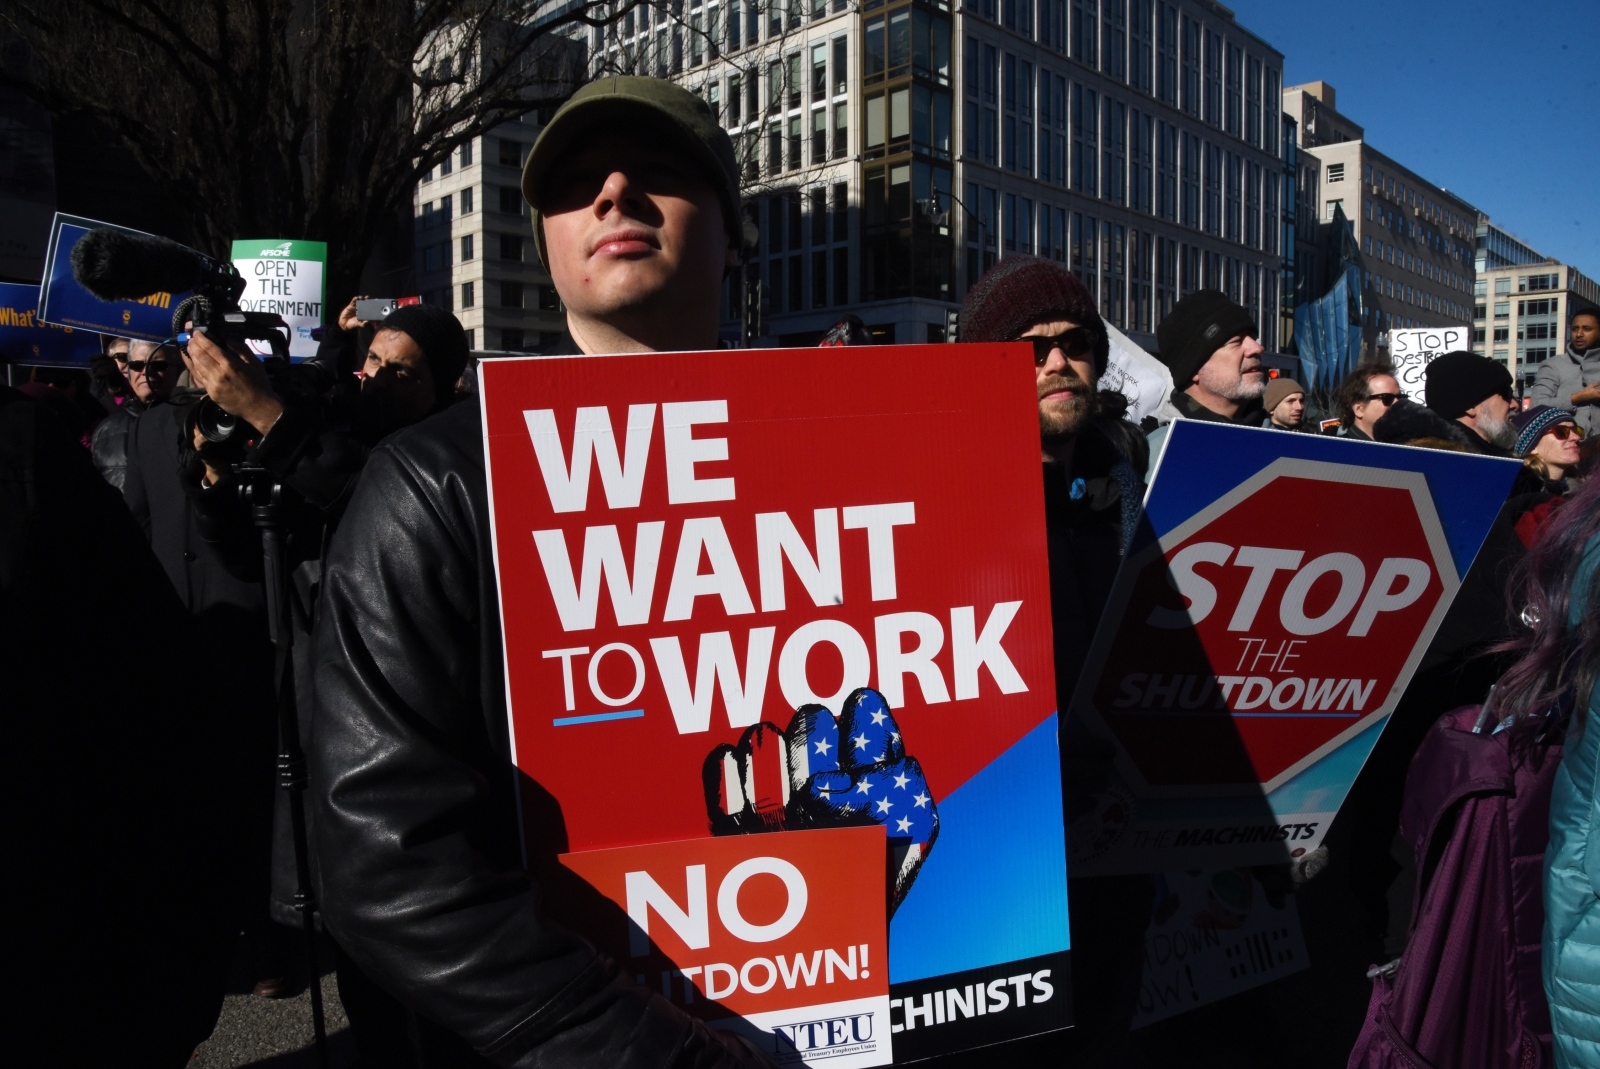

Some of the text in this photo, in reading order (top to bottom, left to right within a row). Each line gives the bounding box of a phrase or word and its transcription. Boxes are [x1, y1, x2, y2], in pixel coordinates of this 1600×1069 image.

[254, 260, 297, 277] OPEN
[260, 249, 290, 257] AFSCME
[258, 279, 292, 296] THE
[240, 299, 321, 318] OVERNMENT
[1395, 331, 1458, 352] STOP
[1118, 367, 1139, 387] WORK
[522, 399, 736, 514] WE
[532, 501, 916, 632] WANT
[1145, 541, 1432, 638] STOP
[542, 600, 1030, 735] TO WORK
[1236, 637, 1307, 673] THE
[1112, 672, 1378, 712] SHUTDOWN
[1132, 822, 1319, 849] THE MACHINISTS
[624, 856, 809, 958] NO
[889, 968, 1054, 1033] CHINISTS
[1138, 963, 1199, 1014] OW!
[772, 1014, 875, 1054] NTEU
[808, 1050, 831, 1058] Treasury
[832, 1045, 860, 1055] Employees
[860, 1042, 876, 1051] Union
